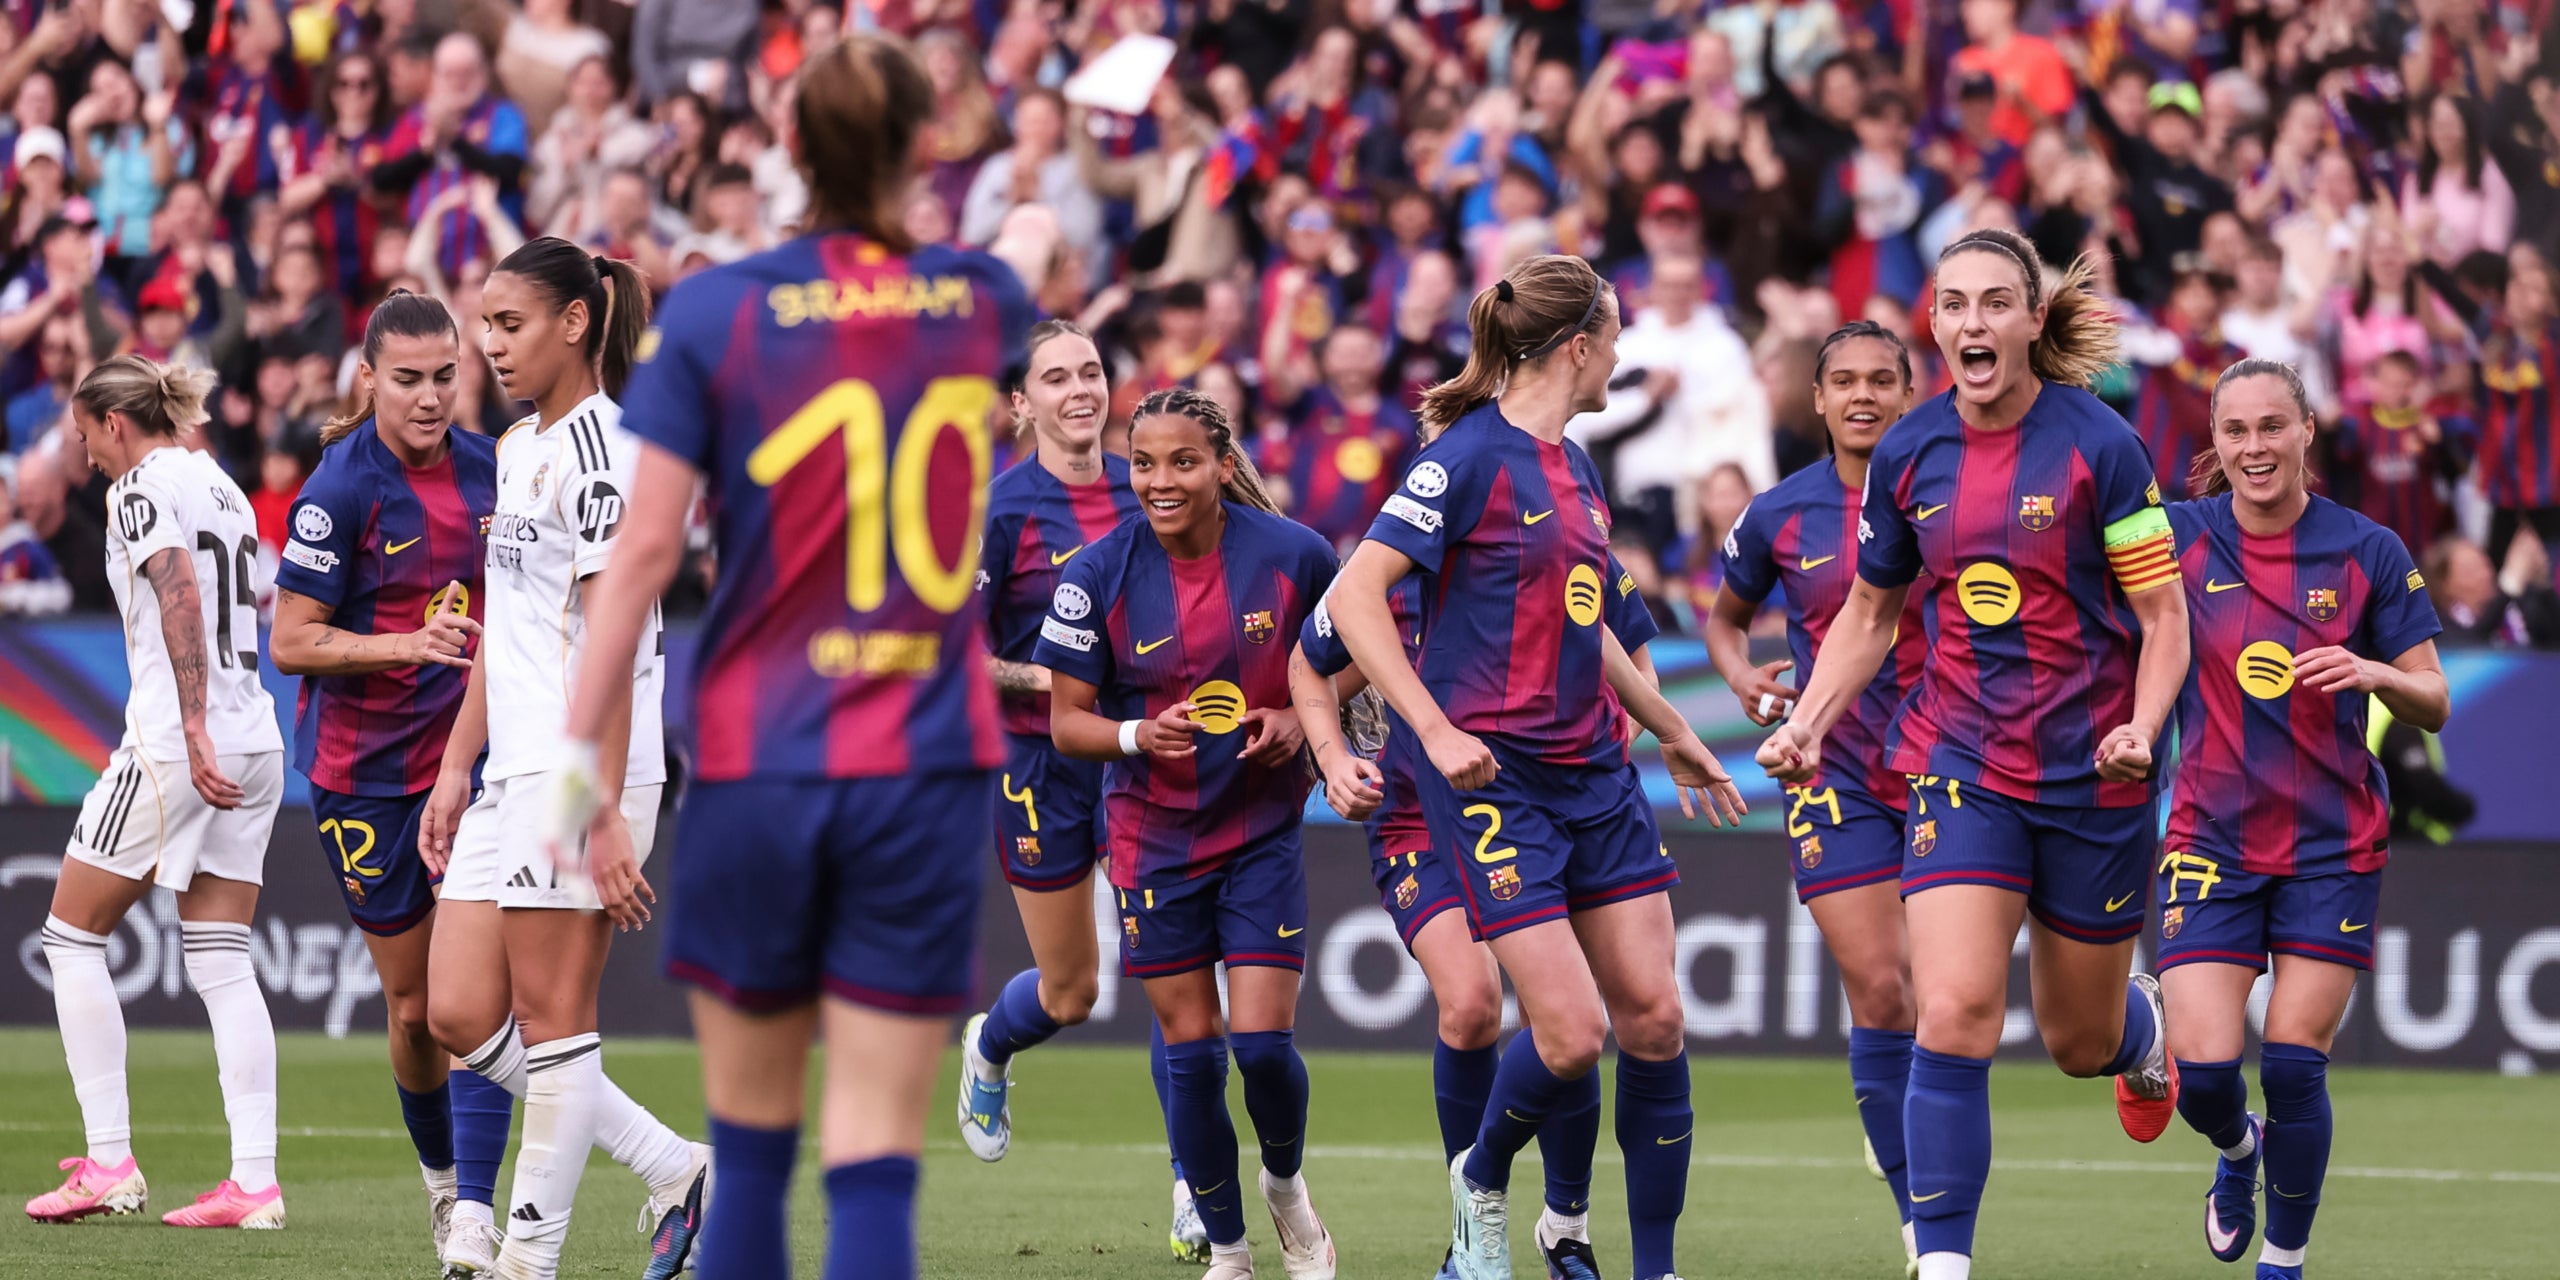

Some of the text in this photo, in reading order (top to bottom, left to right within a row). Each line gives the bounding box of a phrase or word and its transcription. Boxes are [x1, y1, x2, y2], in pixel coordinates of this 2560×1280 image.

[118, 495, 153, 542] hp
[579, 481, 622, 543] hp
[745, 374, 998, 613] 10
[1003, 773, 1039, 832] 4
[1786, 786, 1842, 838] 24
[319, 818, 384, 876] 12
[1463, 804, 1518, 864] 2
[2158, 851, 2221, 904] 17
